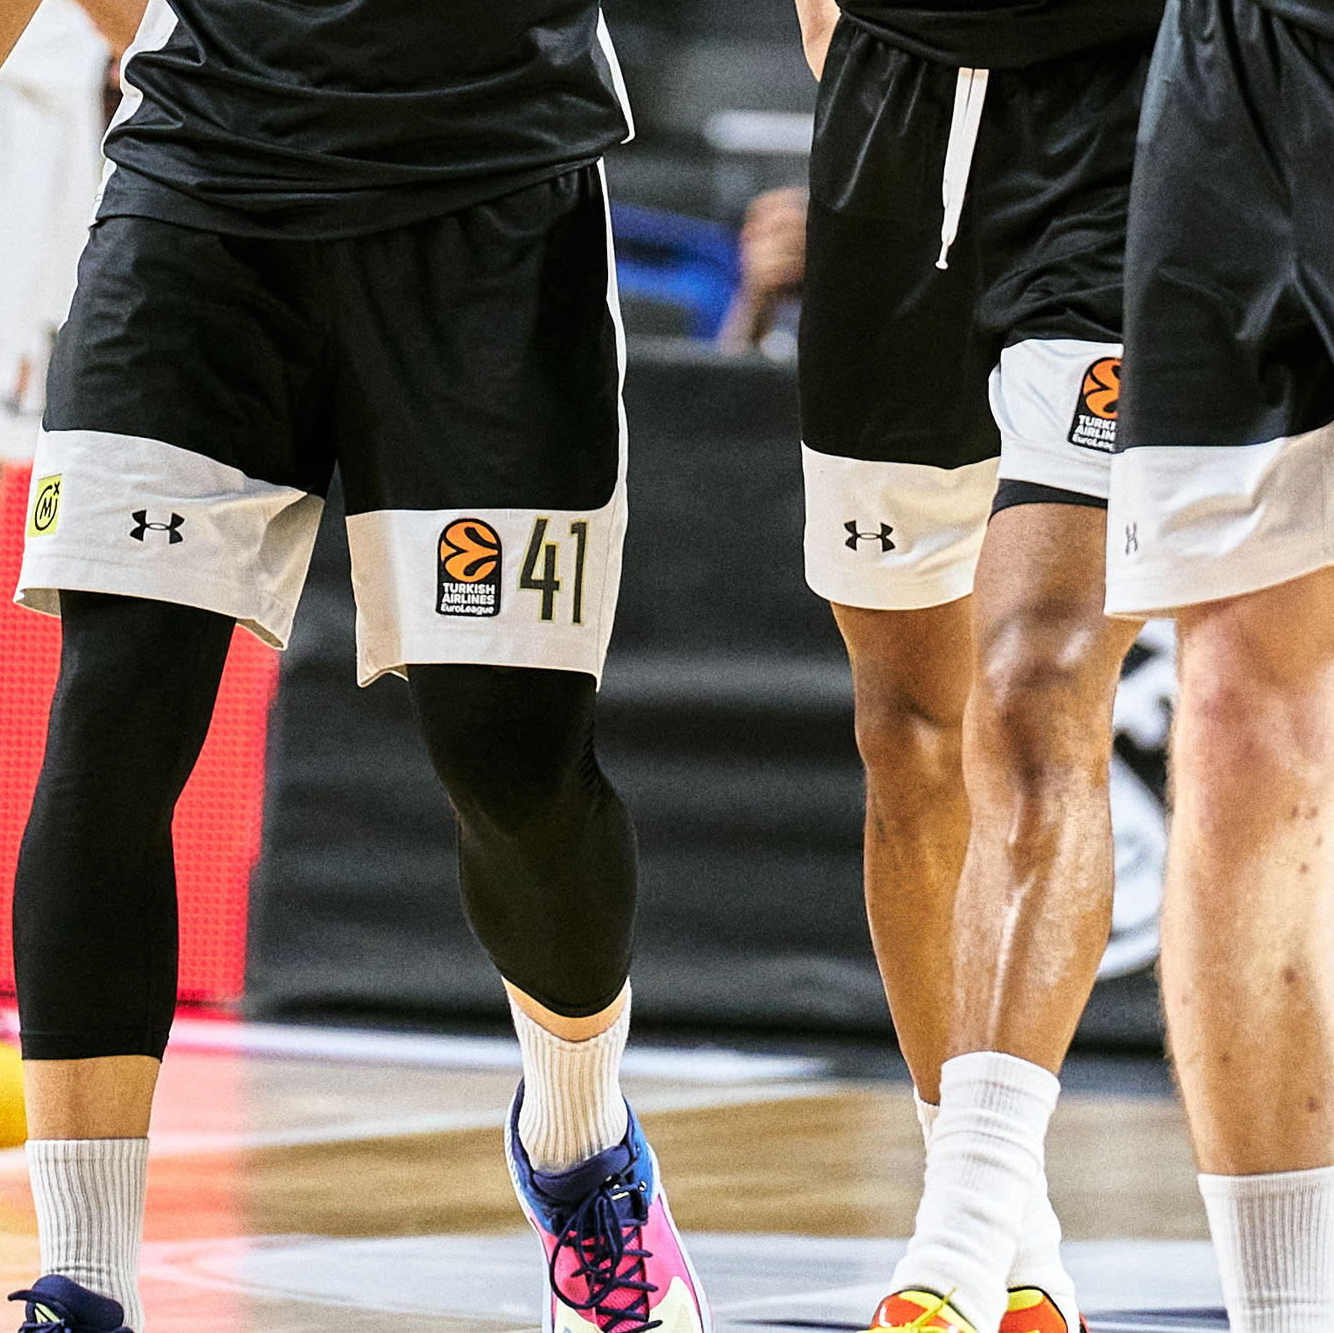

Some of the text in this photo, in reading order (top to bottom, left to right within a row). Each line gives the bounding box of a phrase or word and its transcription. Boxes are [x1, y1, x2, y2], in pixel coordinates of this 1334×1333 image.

[1078, 414, 1116, 430] TURKI
[1075, 425, 1116, 441] AIRLIN
[519, 516, 589, 626] 41
[442, 583, 495, 595] TURKISH
[442, 593, 495, 605] AIRLINES
[441, 603, 494, 615] EuroLeague
